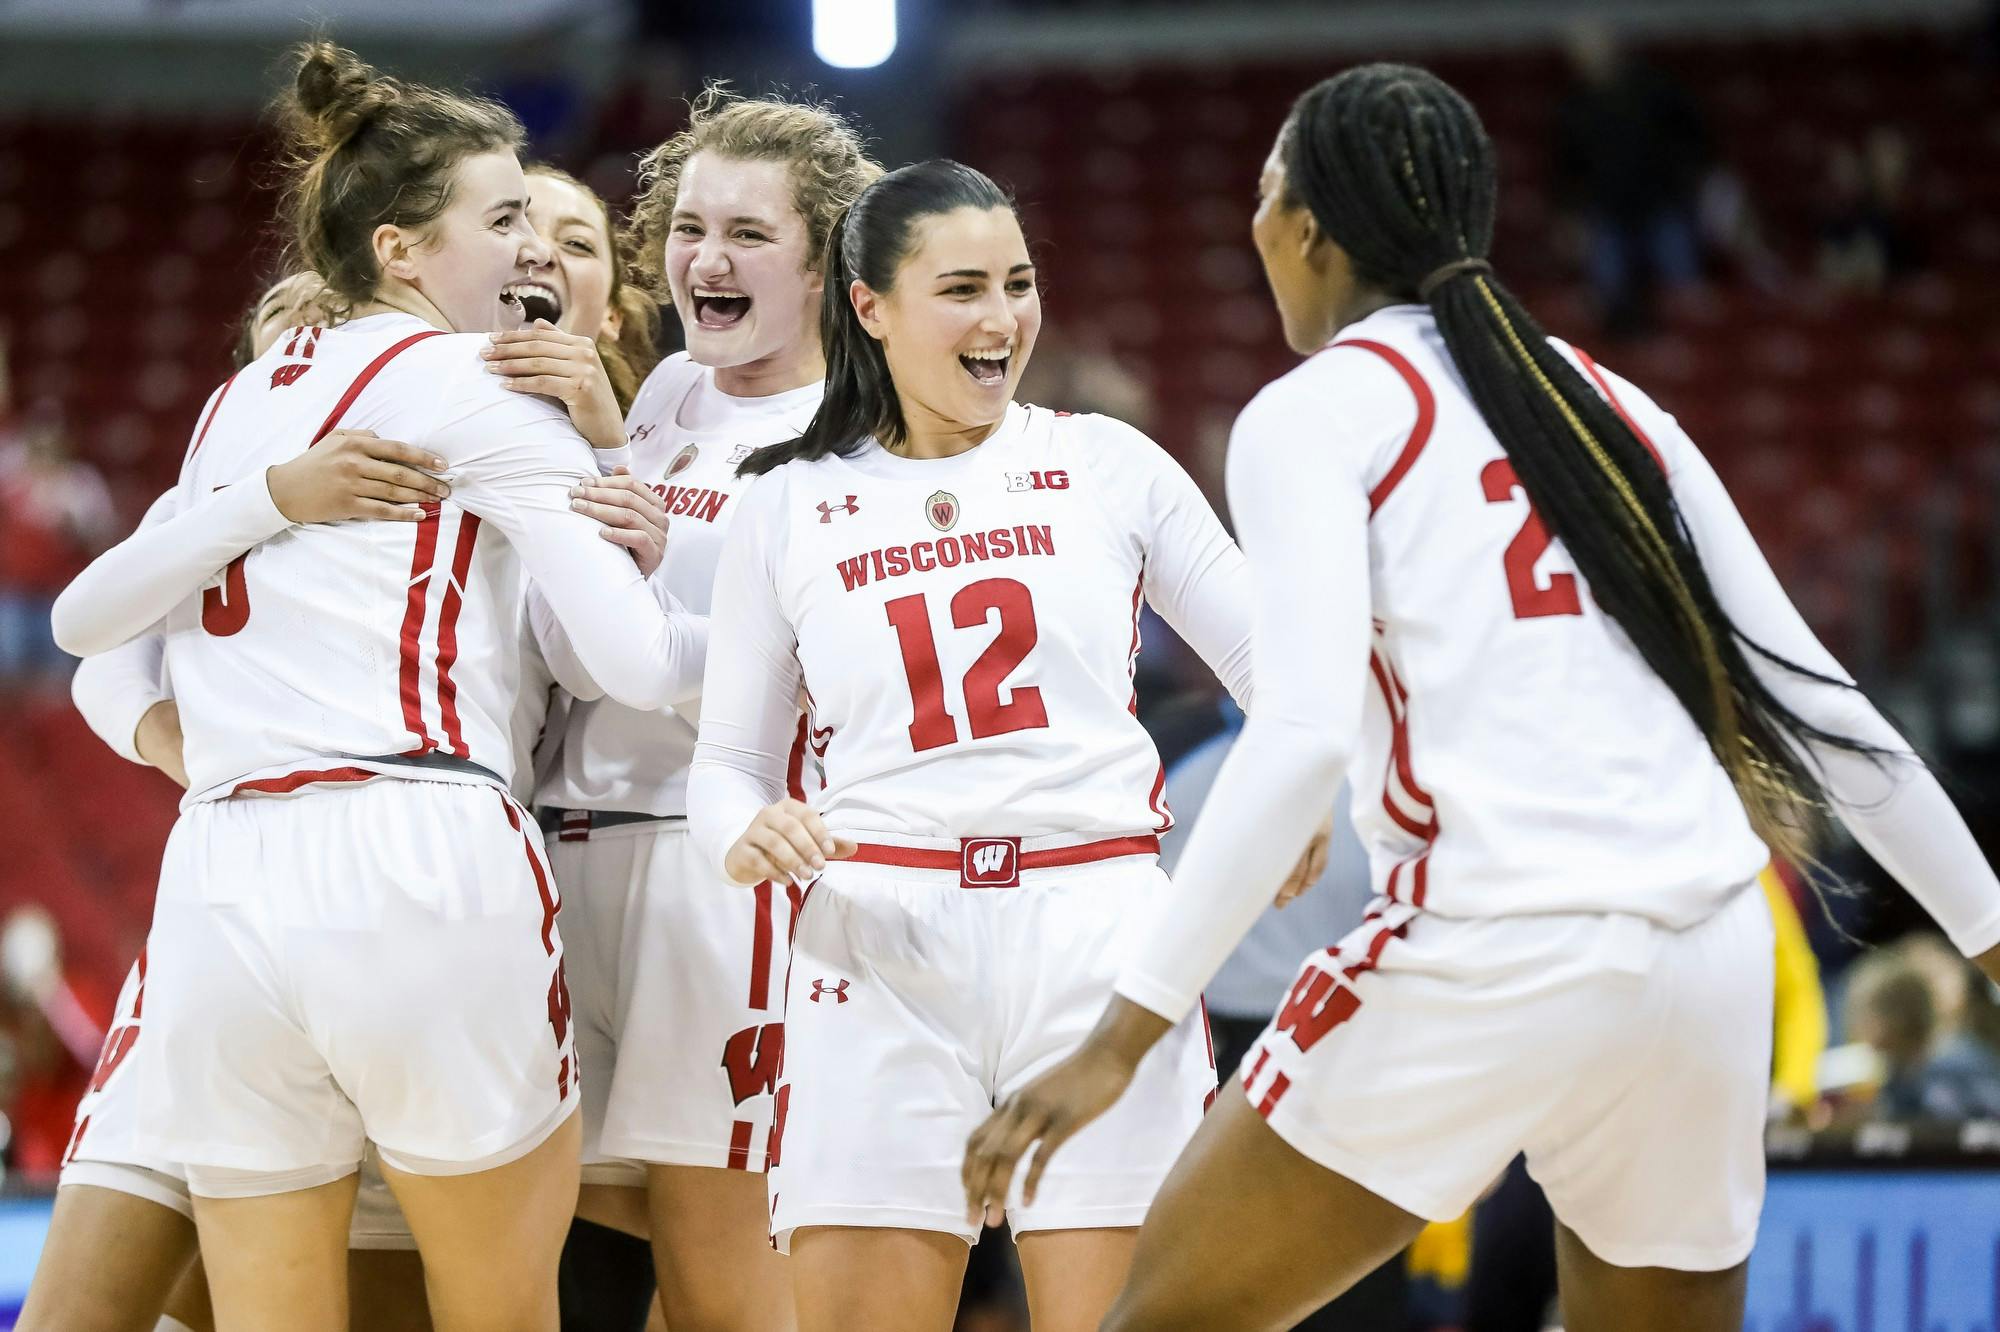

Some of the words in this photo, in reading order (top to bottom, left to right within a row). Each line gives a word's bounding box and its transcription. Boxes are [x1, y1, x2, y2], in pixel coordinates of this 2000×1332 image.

[836, 525, 1056, 593] WISCONSIN
[884, 577, 1050, 752] 12
[972, 844, 1009, 877] W
[1276, 965, 1362, 1053] W
